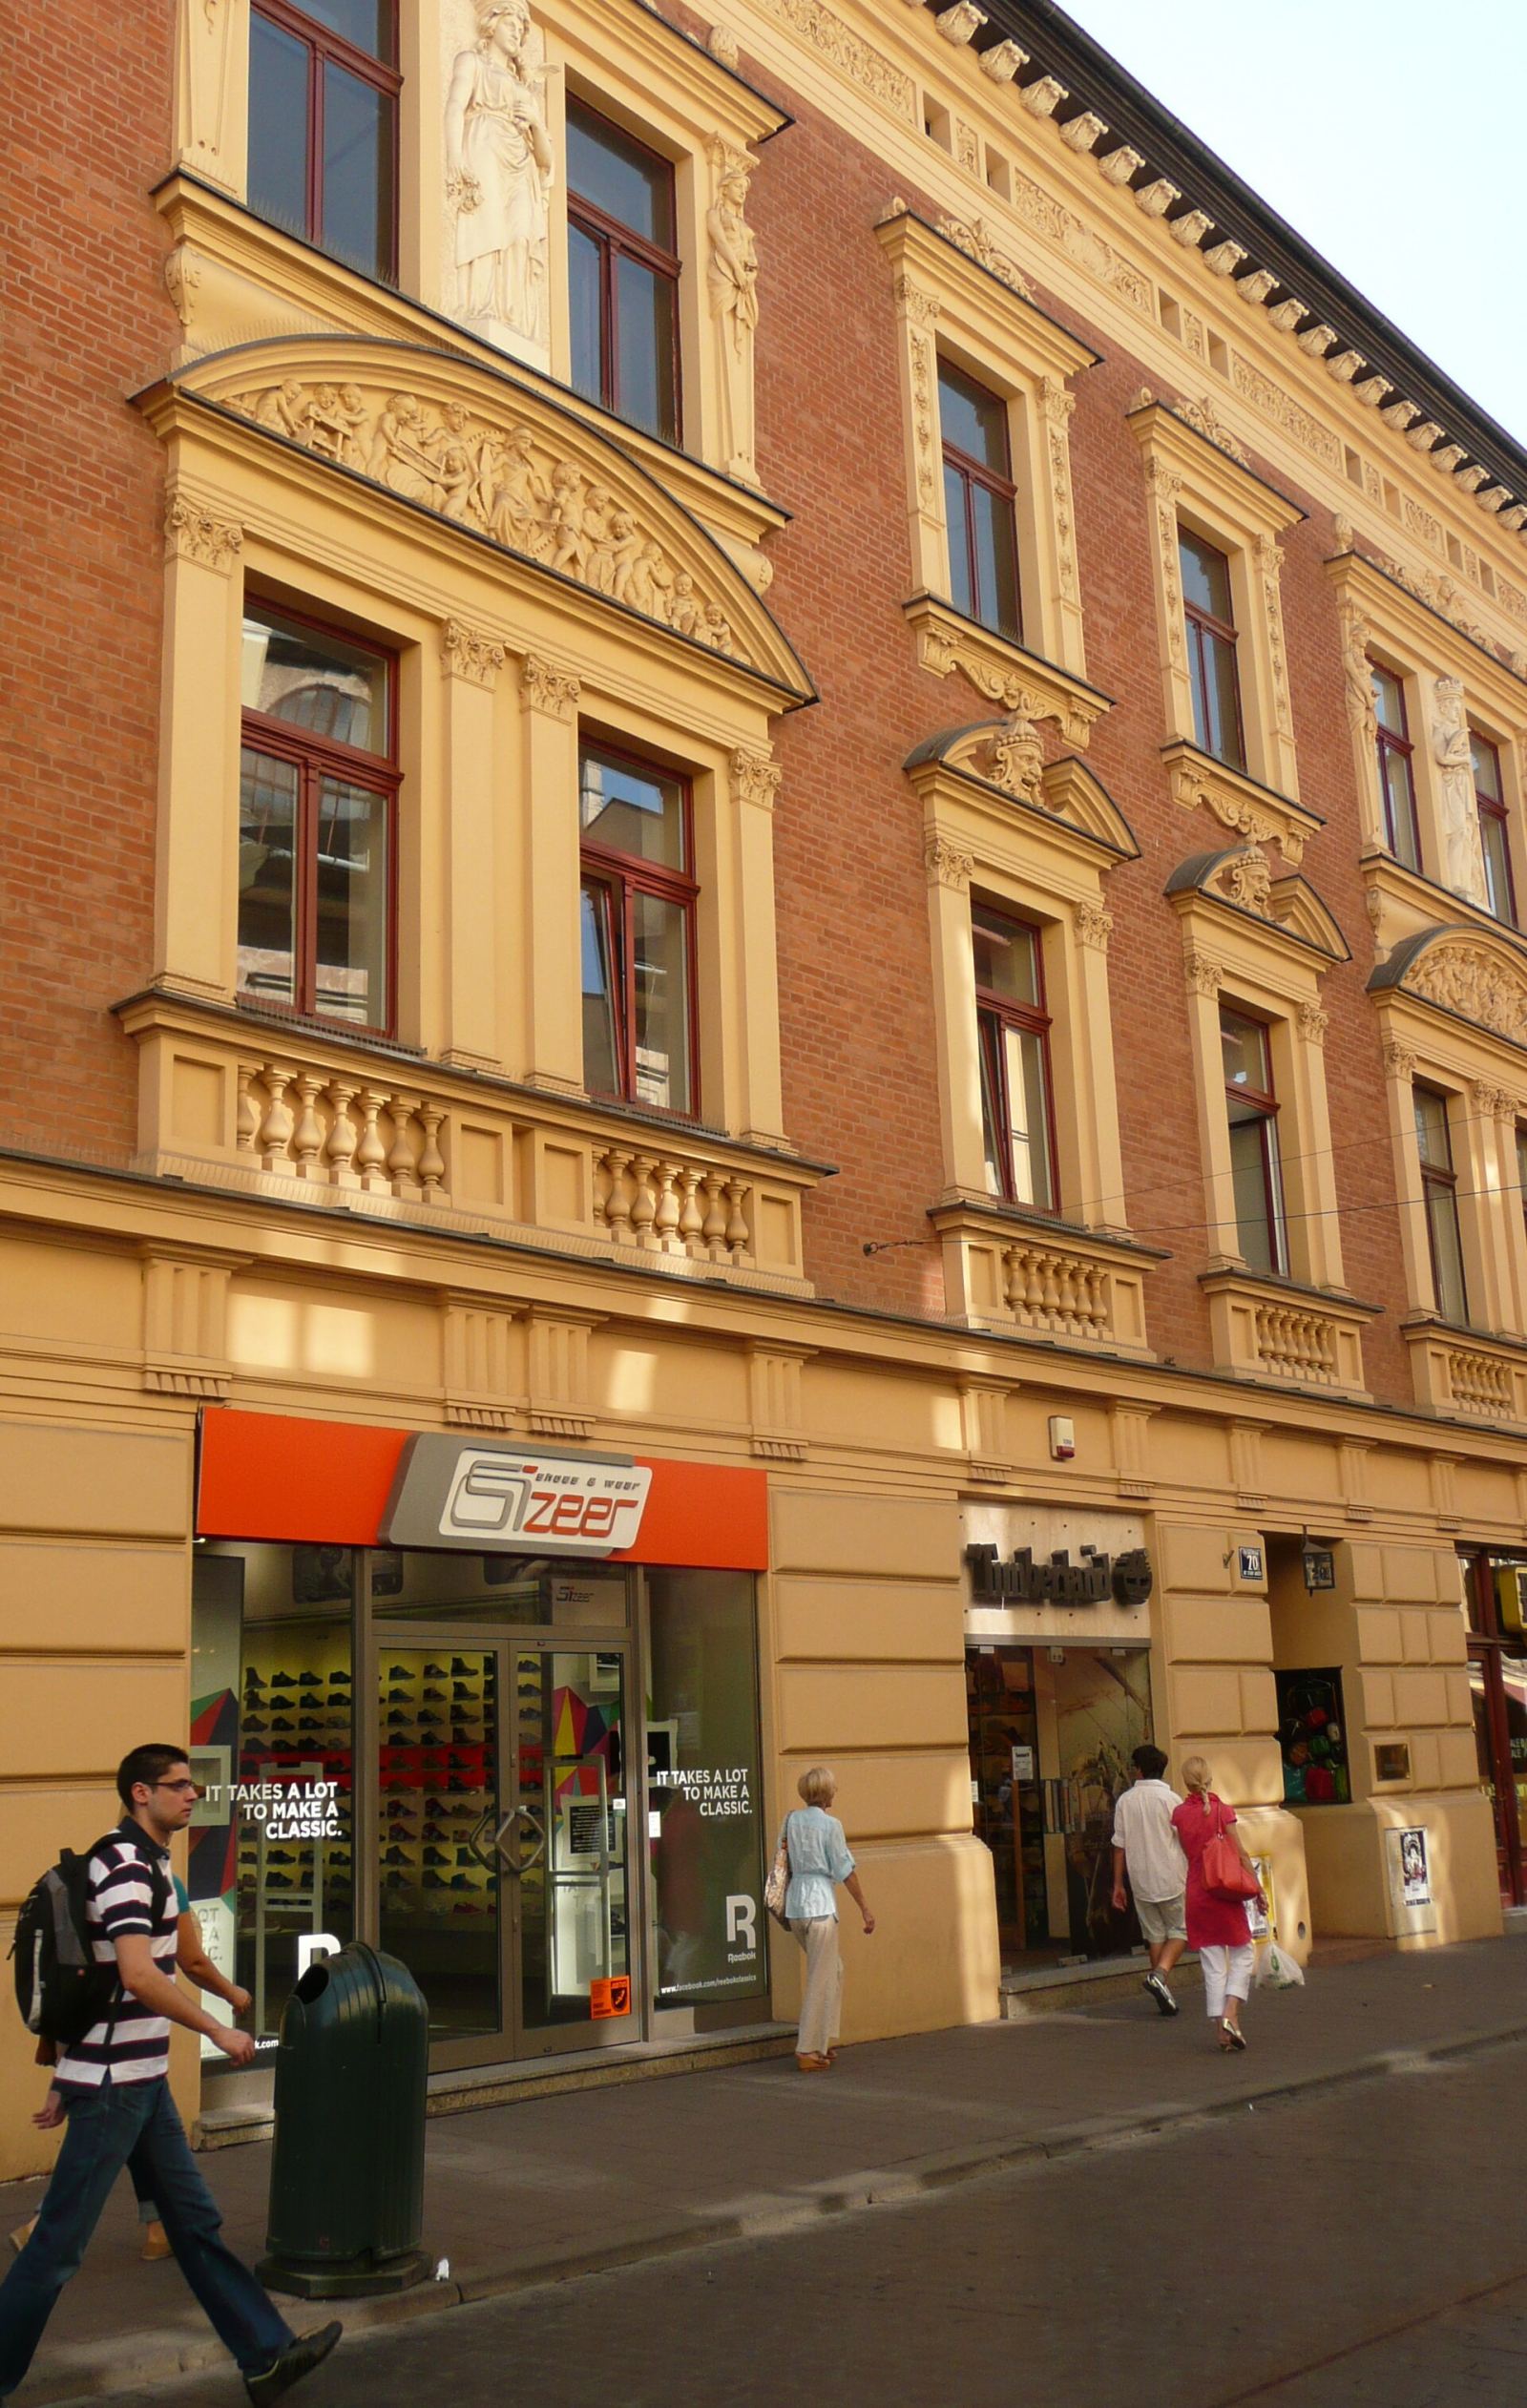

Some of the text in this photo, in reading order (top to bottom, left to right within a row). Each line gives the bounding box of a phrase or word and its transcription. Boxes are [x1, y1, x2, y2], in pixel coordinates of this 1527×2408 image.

[604, 1479, 640, 1490] wear
[450, 1459, 639, 1539] Sizeer
[966, 1542, 1113, 1603] Timberland
[1246, 1555, 1259, 1571] 20
[657, 1769, 748, 1786] IT TAKES A LOT
[205, 1782, 337, 1802] IT TAKES A LOT
[683, 1785, 749, 1801] TO MAKE A
[243, 1801, 339, 1820] TO MAKE A
[700, 1800, 752, 1815] CLASSIC.
[266, 1820, 342, 1839] CLASSIC.
[725, 1895, 756, 1949] R
